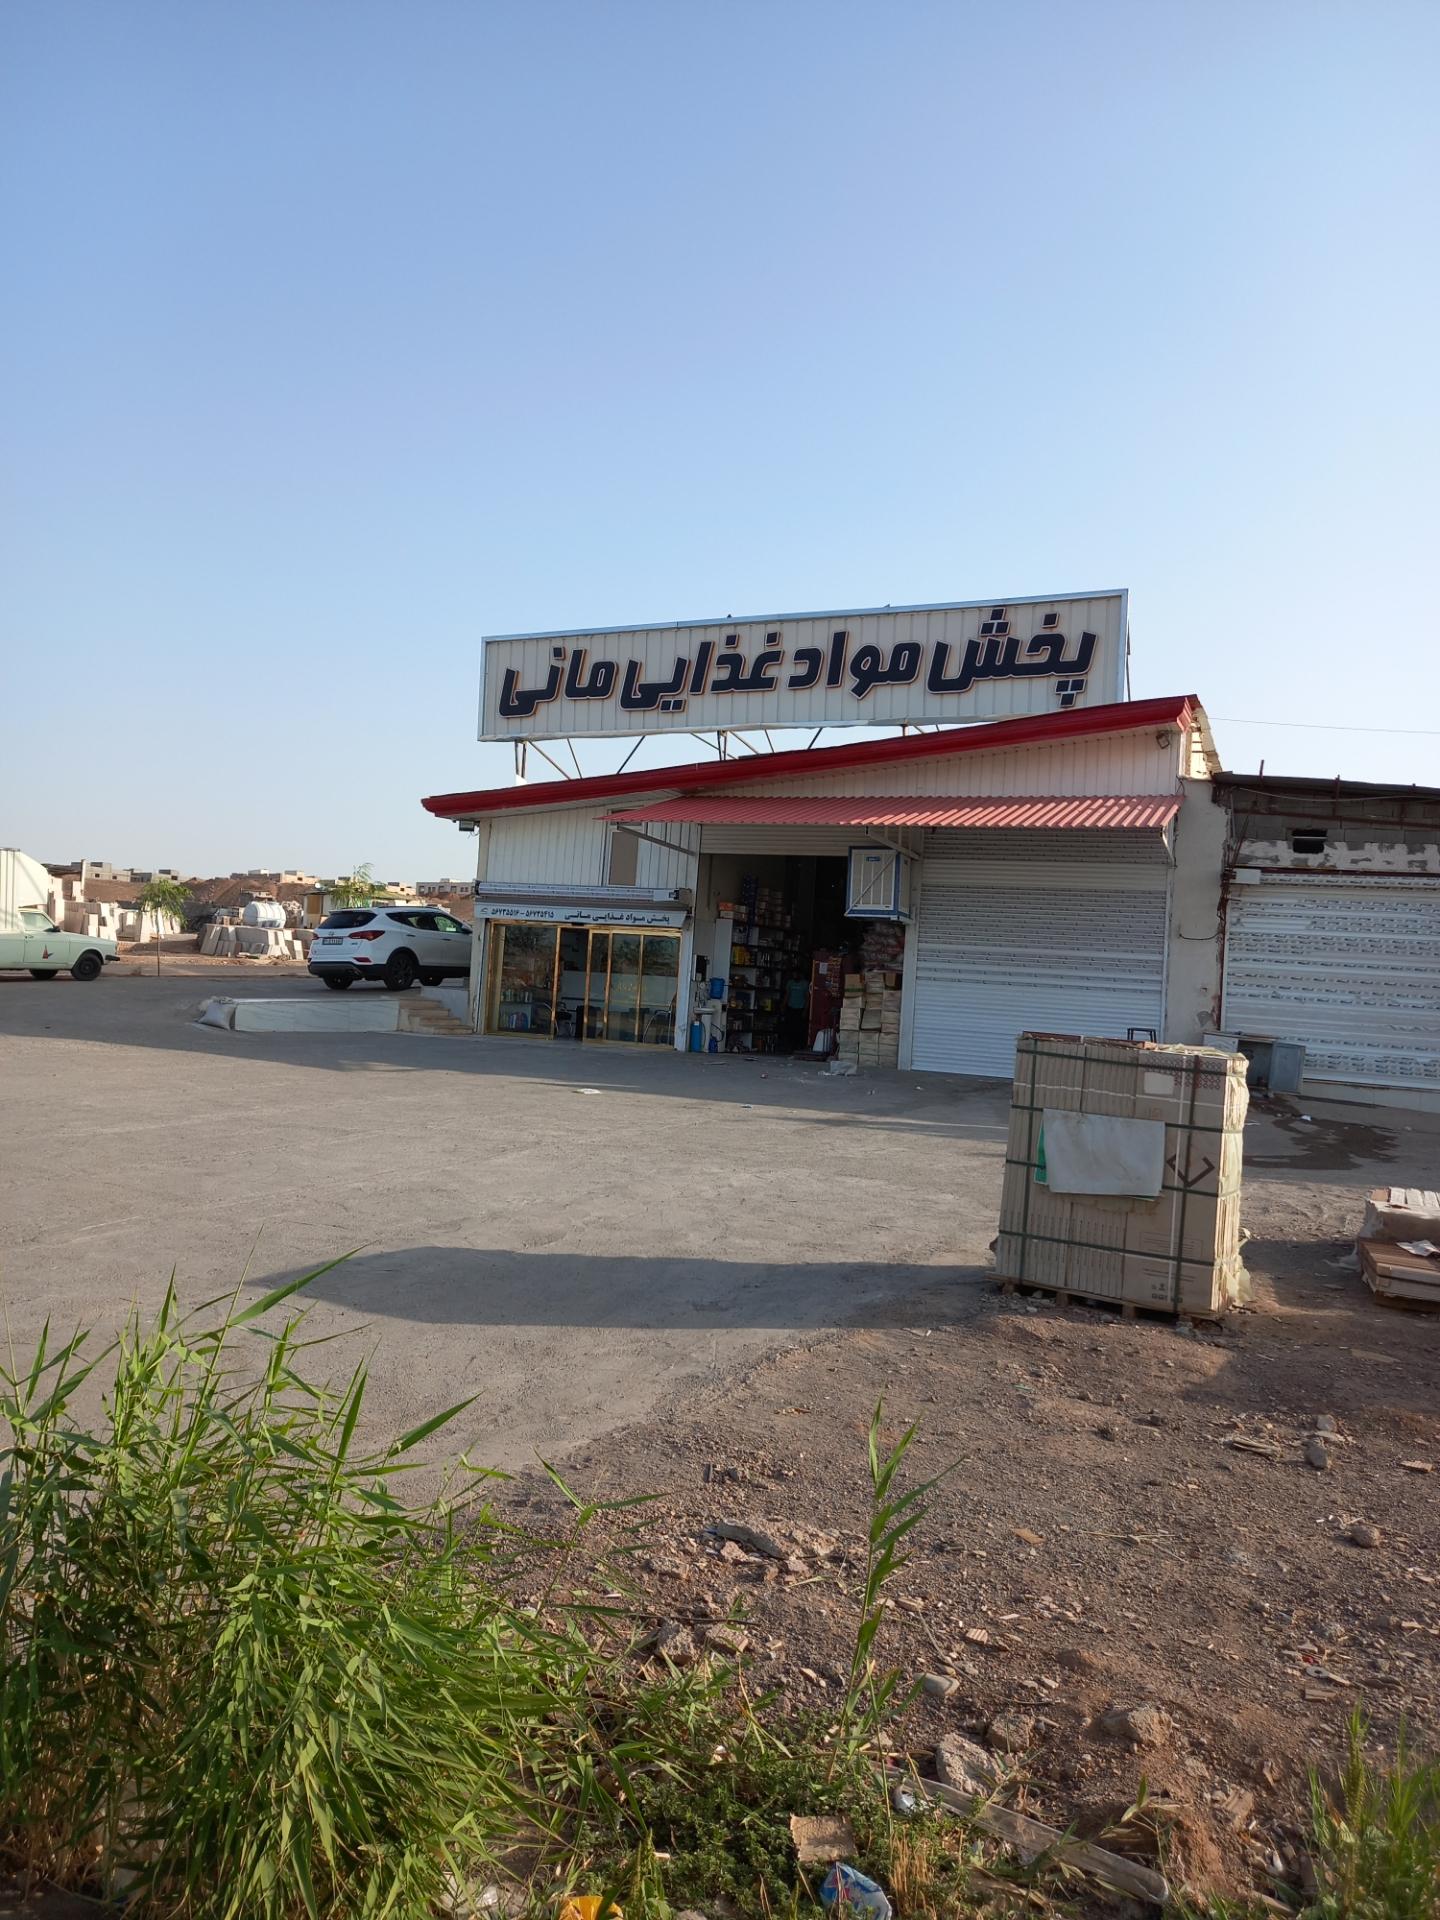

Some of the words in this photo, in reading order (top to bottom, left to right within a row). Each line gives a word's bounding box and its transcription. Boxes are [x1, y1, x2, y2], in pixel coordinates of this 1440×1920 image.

[496, 645, 617, 720] مانی
[617, 631, 787, 714] غذایی
[786, 629, 924, 701] مواد
[925, 608, 1098, 711] پخش
